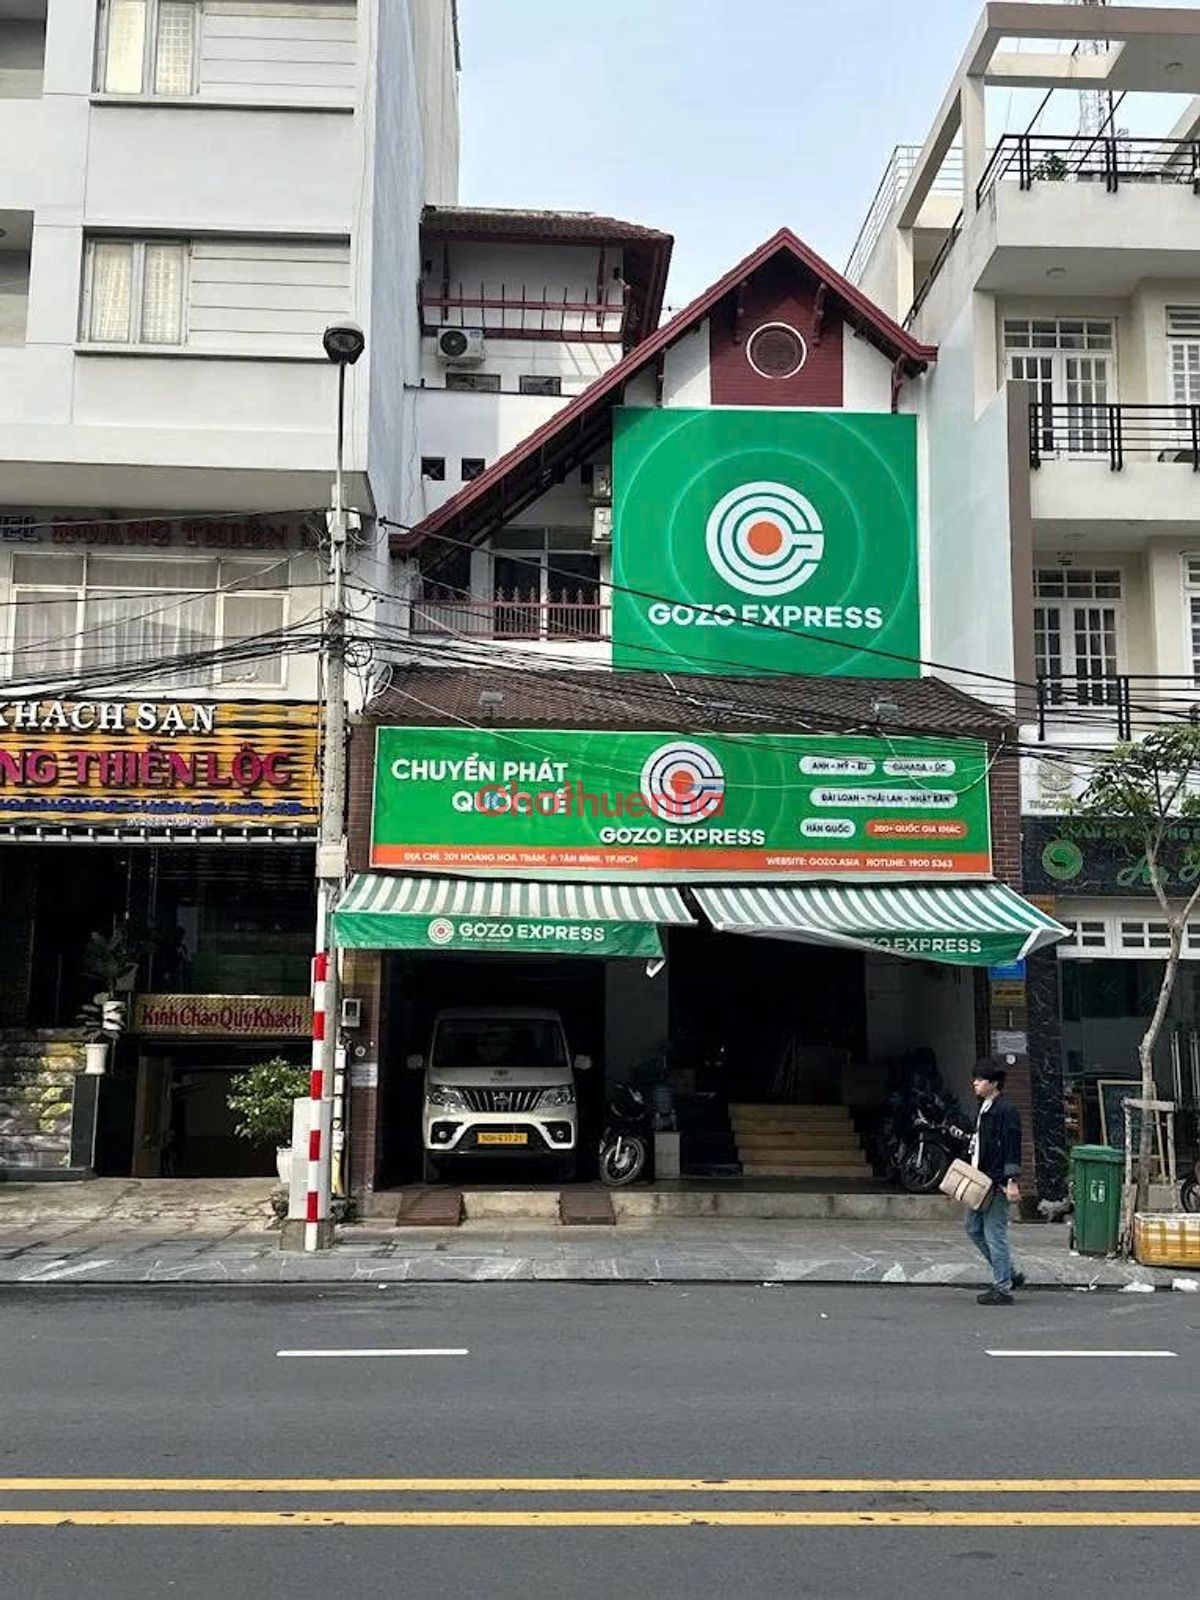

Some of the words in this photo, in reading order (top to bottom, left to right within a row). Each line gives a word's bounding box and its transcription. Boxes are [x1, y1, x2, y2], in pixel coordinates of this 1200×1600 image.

[648, 603, 735, 626] GOZO
[742, 604, 883, 629] EXPRESS
[136, 703, 216, 736] SẠN
[207, 741, 291, 796] LỘC
[503, 758, 569, 782] PHÁT
[599, 827, 662, 845] GOZO
[665, 828, 766, 846] EXPRESS
[909, 859, 930, 868] 1900
[458, 922, 514, 938] GOZO
[517, 924, 606, 943] EXPRESS
[894, 937, 982, 954] EXPRESS
